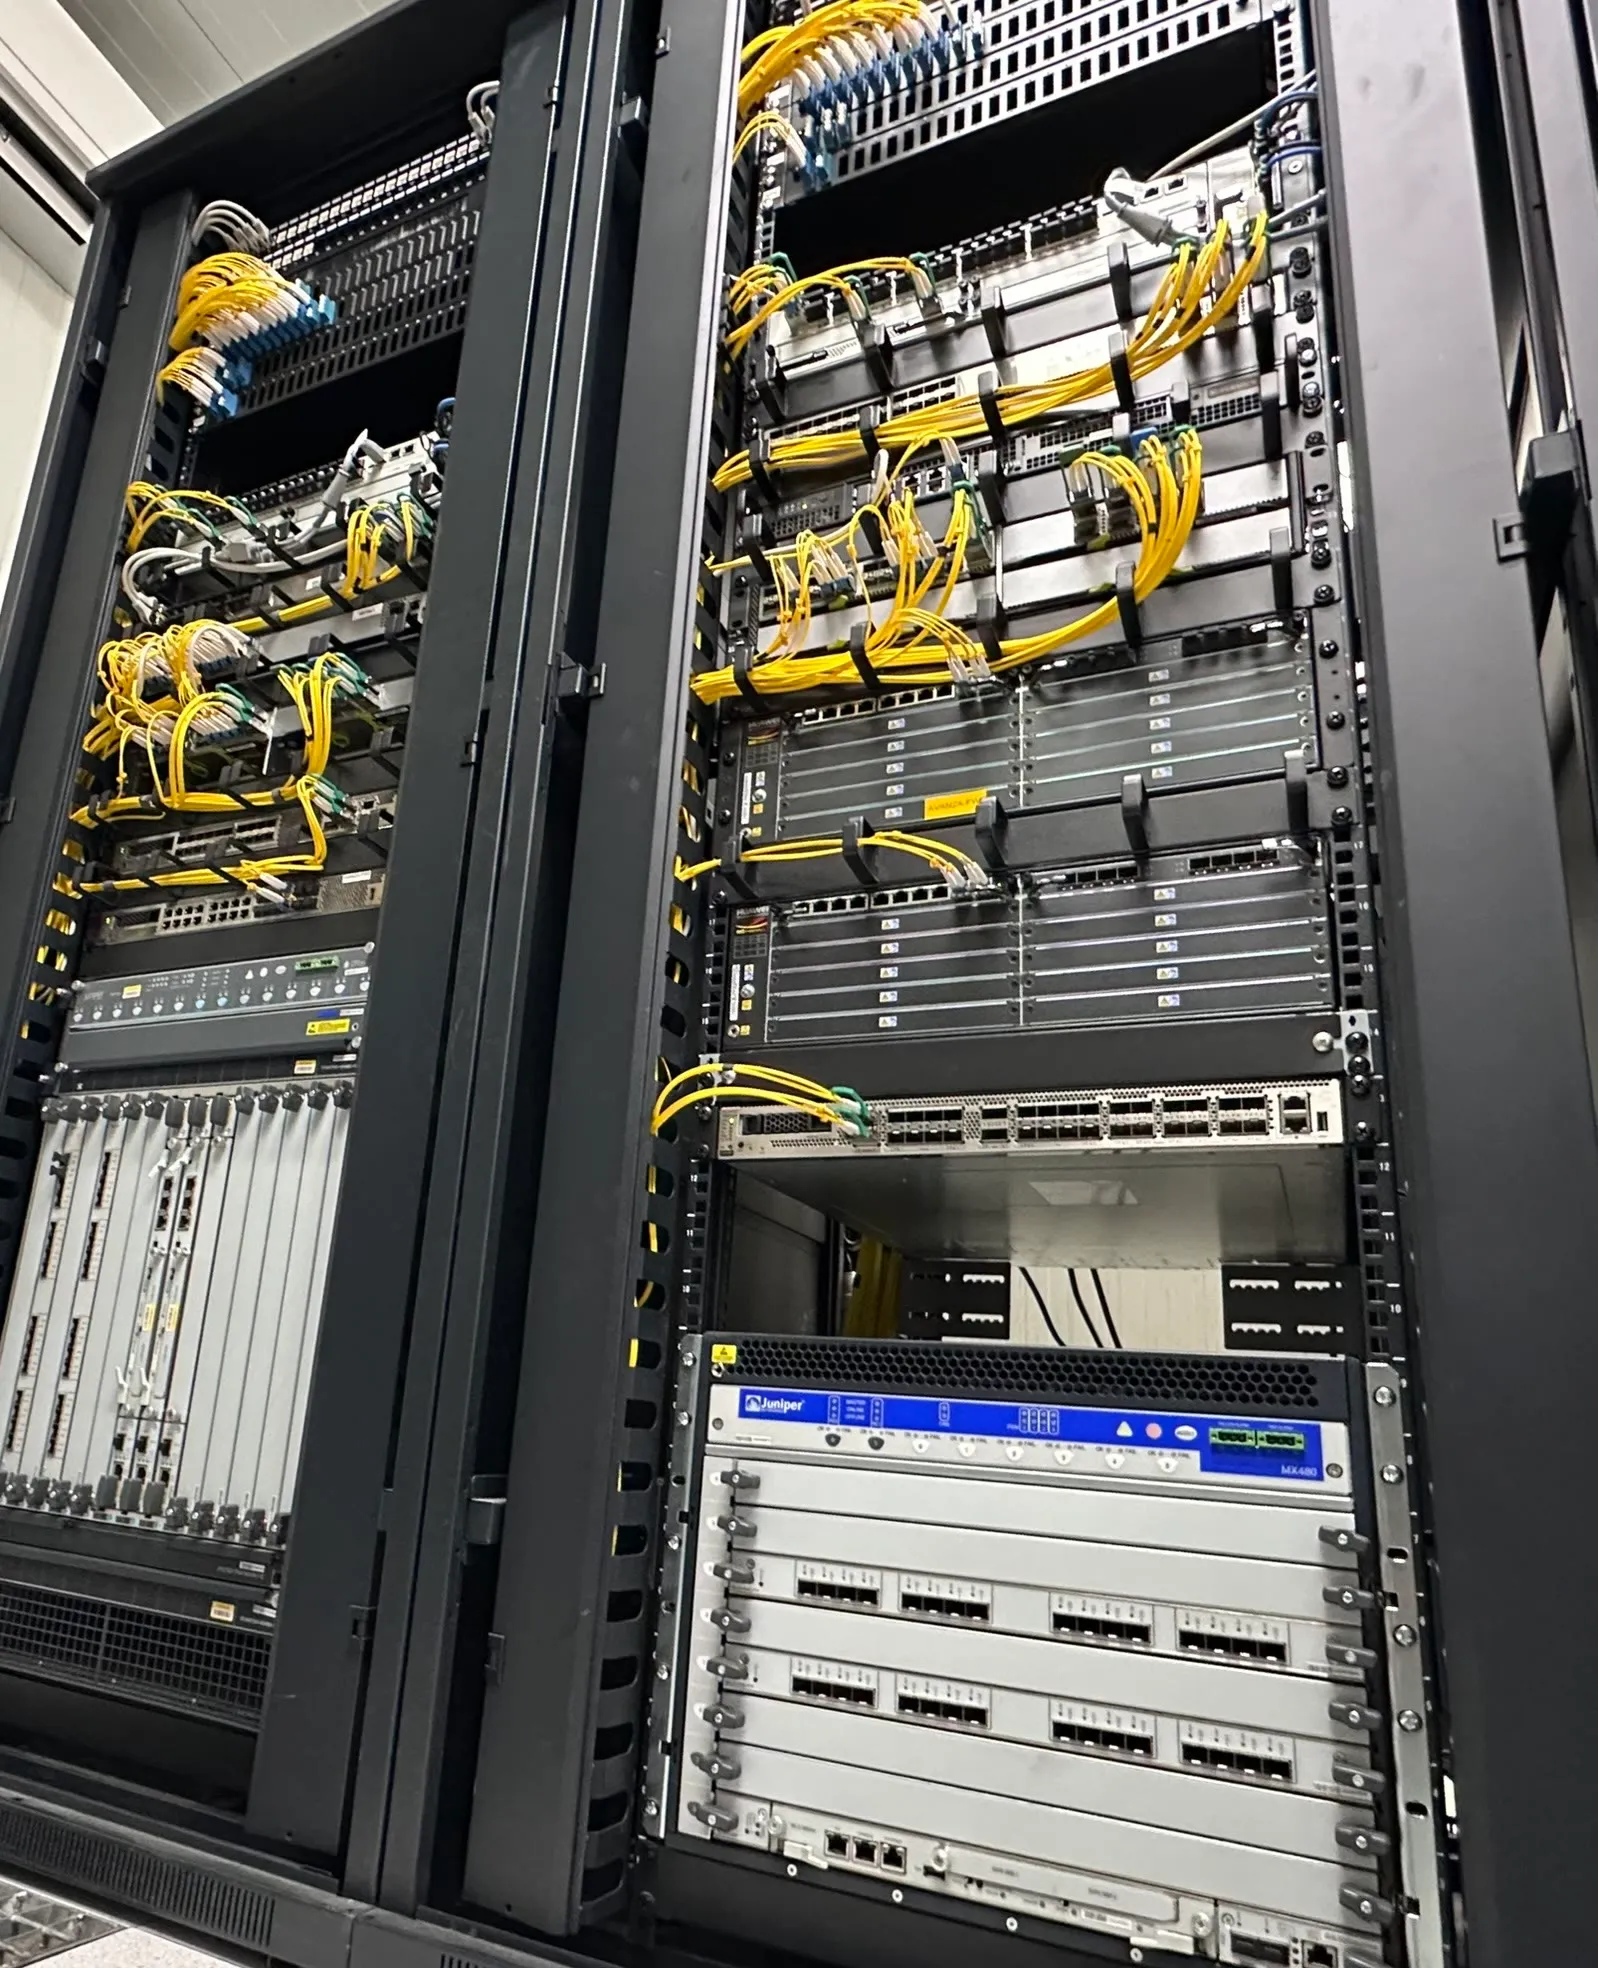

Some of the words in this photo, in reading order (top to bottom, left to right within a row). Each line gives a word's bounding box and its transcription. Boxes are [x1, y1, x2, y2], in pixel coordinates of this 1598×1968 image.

[1379, 1161, 1390, 1171] 12
[1385, 1232, 1395, 1241] 11
[1390, 1304, 1402, 1314] 10
[762, 1397, 803, 1414] Juniper
[1281, 1464, 1318, 1477] MX480
